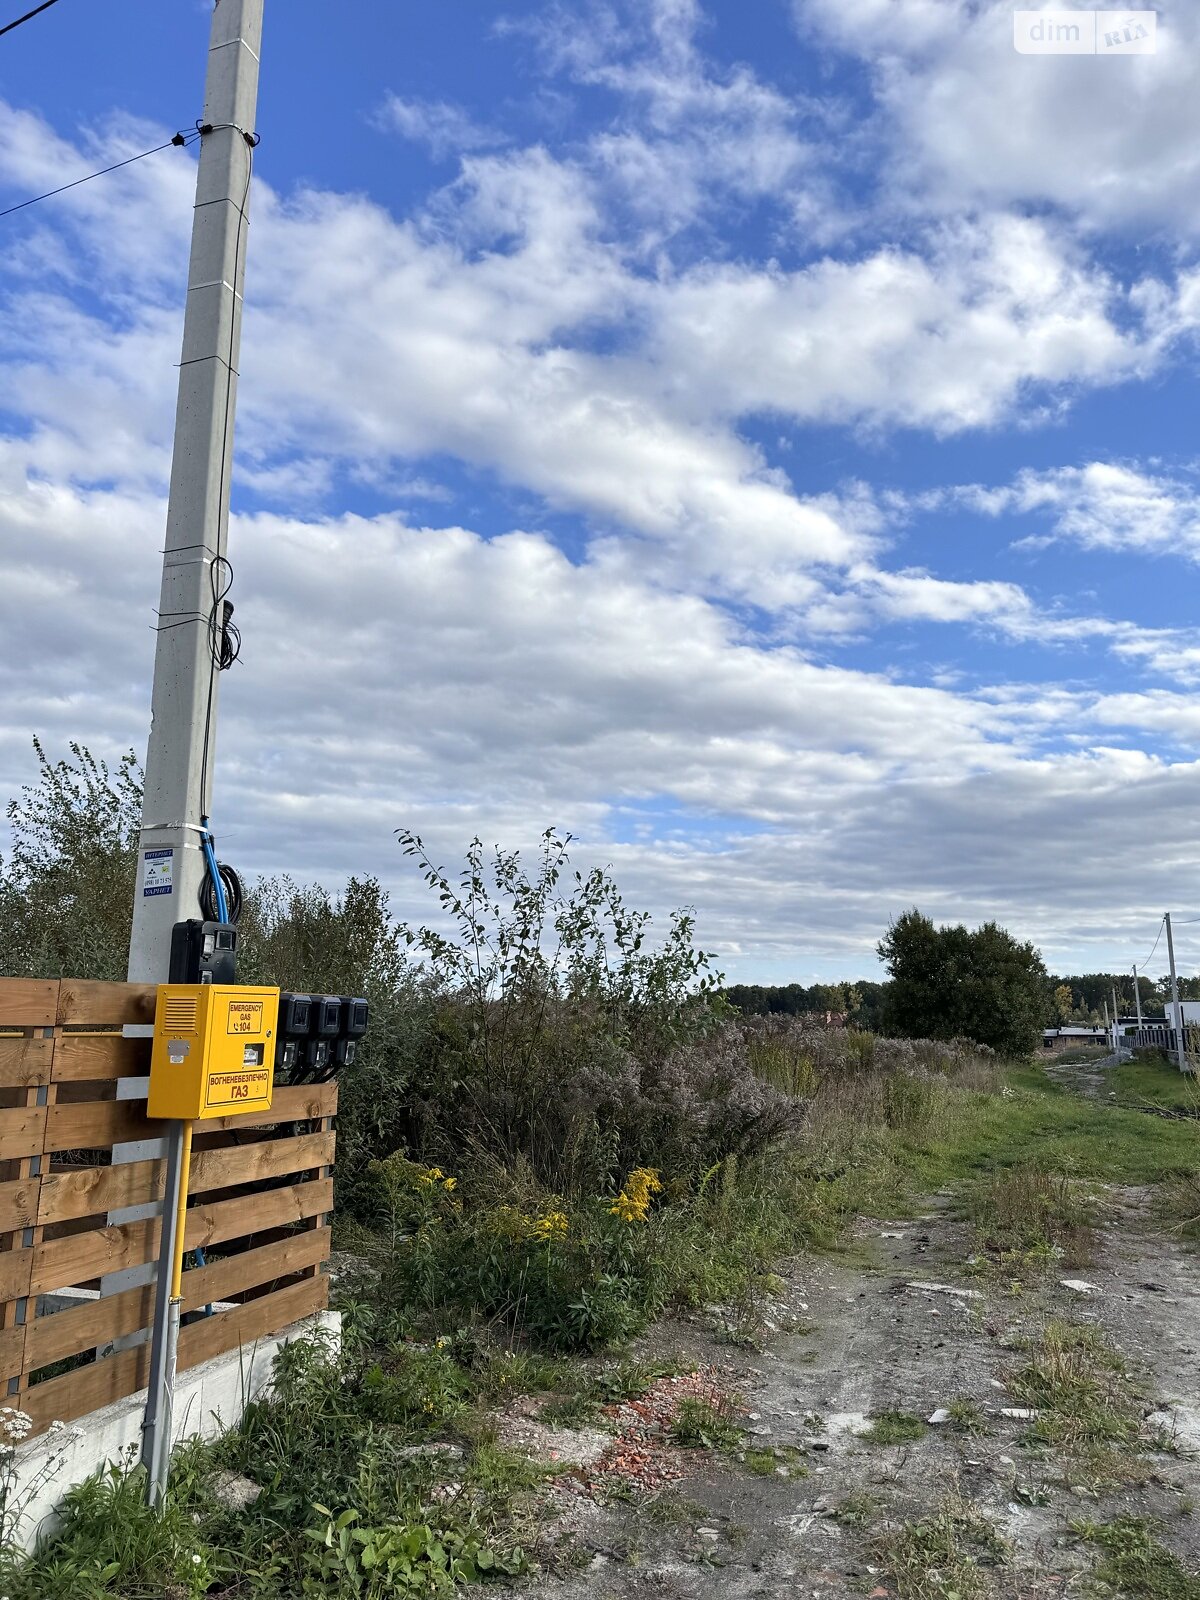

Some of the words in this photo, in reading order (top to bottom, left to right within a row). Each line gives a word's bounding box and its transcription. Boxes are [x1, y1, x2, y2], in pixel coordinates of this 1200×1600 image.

[240, 1013, 251, 1021] GAS
[240, 1022, 251, 1031] 104
[210, 1073, 268, 1085] ВОГНЕНЕБЕЗПЕЧНО
[231, 1085, 249, 1098] ГАЗ
